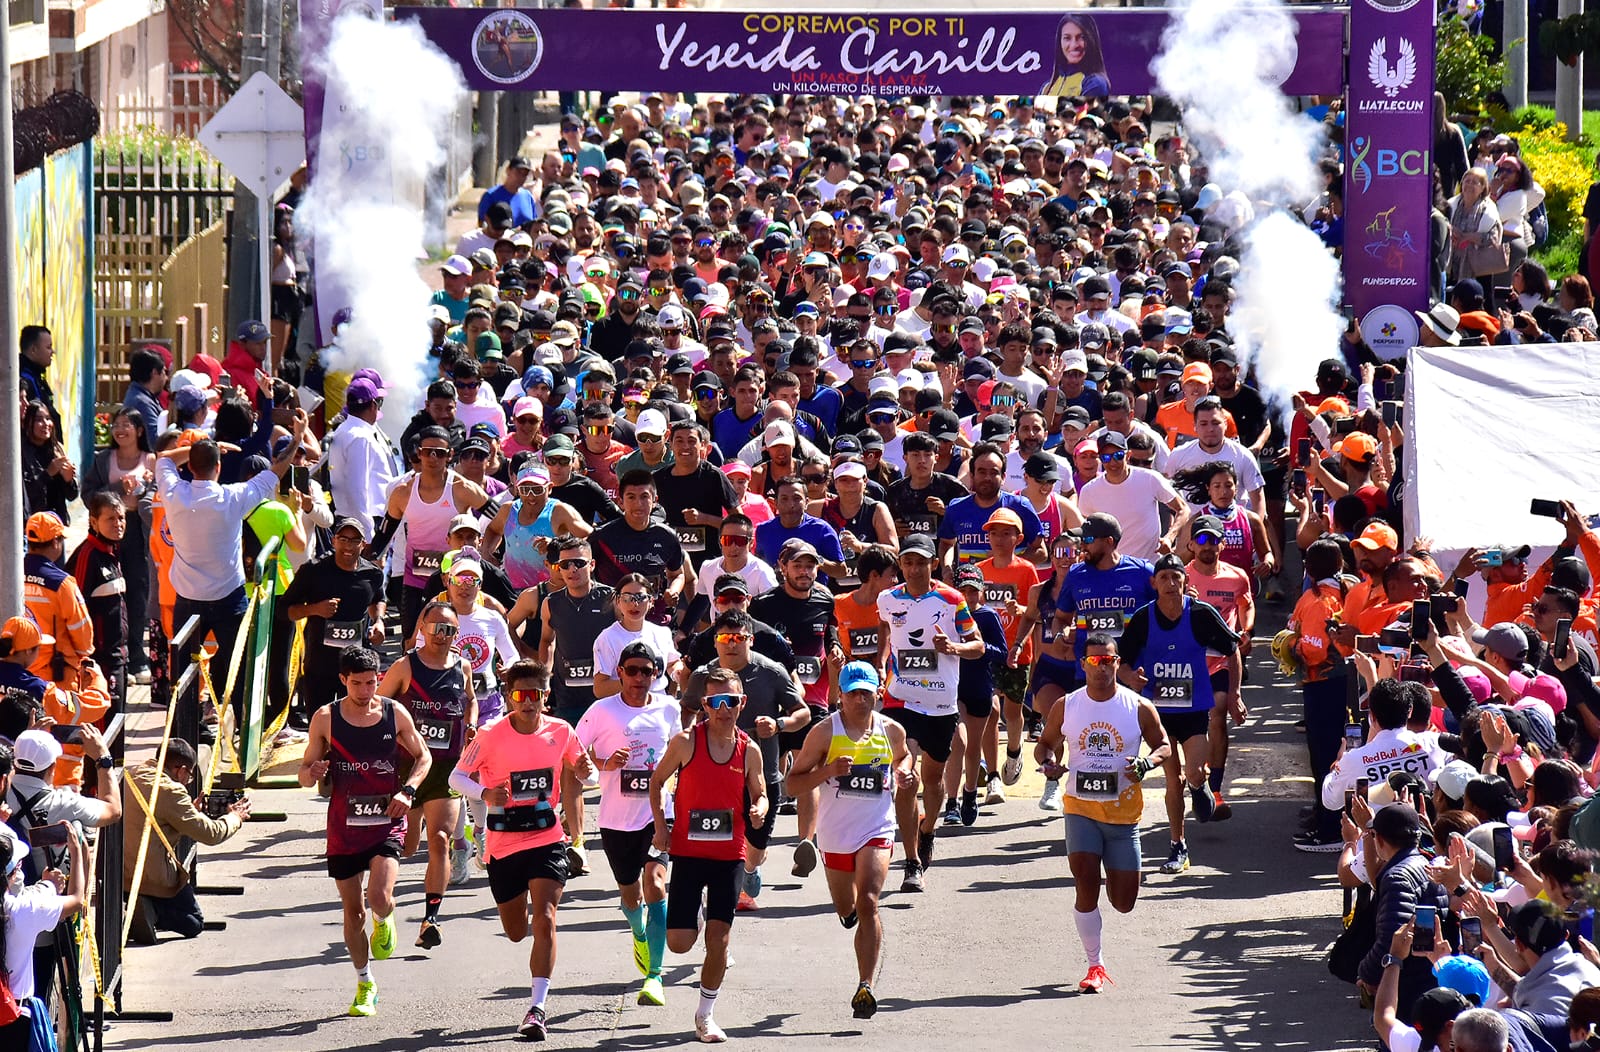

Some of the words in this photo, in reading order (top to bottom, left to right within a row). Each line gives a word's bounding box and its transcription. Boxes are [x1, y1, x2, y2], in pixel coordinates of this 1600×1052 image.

[743, 15, 880, 34] CORREMOS
[889, 18, 938, 36] POR
[945, 18, 964, 36] TI
[655, 21, 822, 72] Yeseida
[840, 26, 1042, 75] Carrillo
[791, 72, 815, 83] UN
[819, 72, 860, 84] PASO
[879, 75, 897, 86] LA
[901, 74, 927, 86] VEZ
[773, 82, 791, 92] UN
[794, 82, 858, 93] KILÓMETRO
[880, 85, 943, 95] ESPERANZA
[1359, 100, 1424, 111] LIATLECUN
[1377, 149, 1429, 176] BCI
[1362, 277, 1418, 286] FUNSDEPCOL
[908, 521, 930, 532] 248
[417, 556, 440, 569] 744
[614, 553, 643, 565] TEMPO
[985, 588, 1012, 600] 1070
[1091, 617, 1116, 630] 952
[331, 627, 356, 640] 339
[856, 633, 878, 646] 270
[905, 656, 930, 668] 734
[569, 666, 592, 678] 357
[1153, 662, 1193, 679] CHIA
[1160, 685, 1185, 698] 295
[411, 700, 442, 711] TEMPO
[419, 724, 446, 739] 508
[1362, 751, 1380, 765] Red
[1379, 748, 1398, 762] Bull
[336, 760, 370, 772] TEMPO
[520, 776, 547, 790] 758
[630, 778, 651, 790] 65
[850, 776, 875, 790] 615
[1083, 779, 1108, 791] 481
[354, 803, 383, 816] 344
[702, 818, 721, 830] 89
